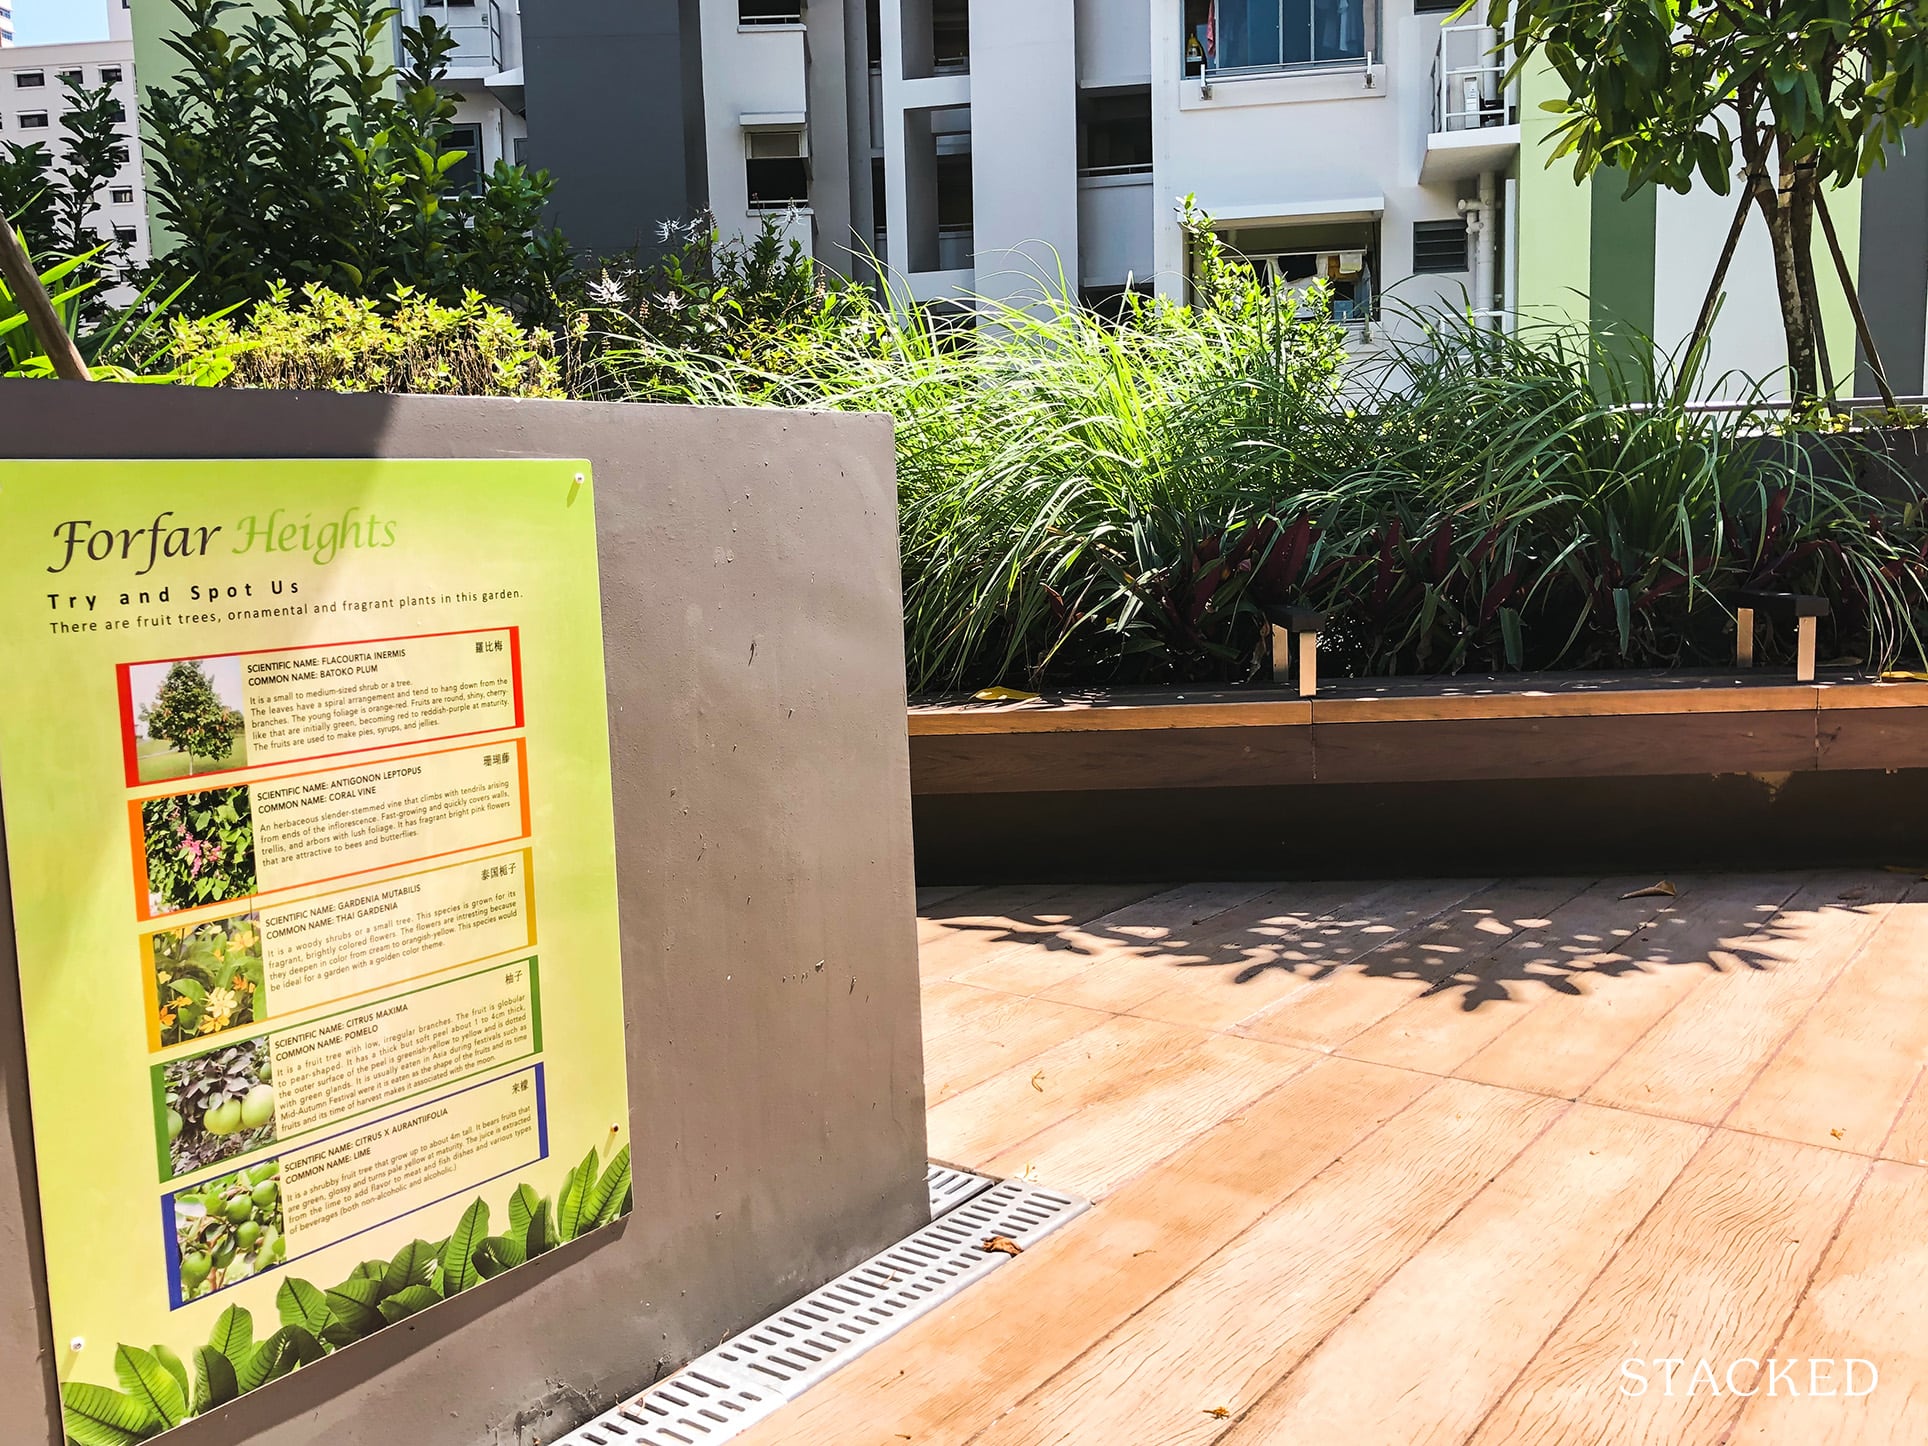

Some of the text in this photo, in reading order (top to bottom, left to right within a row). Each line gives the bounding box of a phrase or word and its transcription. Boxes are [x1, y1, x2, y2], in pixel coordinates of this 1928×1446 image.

[46, 506, 397, 576] Forfar Heights
[47, 580, 299, 611] Try and Spot Us
[49, 588, 522, 633] There are fruit trees, ornamental and fragrant plants in this garden.
[247, 648, 406, 673] SCIENTIFIC NAME: FLACOURTIA INERMIS
[247, 664, 378, 686] COMMON NAME: BATOKO PLUM
[249, 696, 256, 704] It
[257, 695, 264, 704] is
[272, 691, 293, 702] small
[305, 683, 357, 698] medium-sized
[358, 681, 379, 692] shrub
[291, 713, 306, 722] The
[307, 711, 331, 723] young
[332, 707, 358, 717] foliage
[360, 705, 366, 713] is
[410, 698, 430, 706] Fruits
[256, 765, 421, 801] SCIENTIFIC NAME: ANTIGONON LEPTOPUS
[257, 785, 376, 814] COMMON NAME: CORAL VINE
[259, 780, 509, 832] An herbaceous slender-stemmed vine that climbs with tendrils arising
[261, 857, 278, 866] that
[280, 855, 293, 863] are
[295, 847, 332, 860] attractive
[333, 844, 343, 852] to
[344, 840, 362, 850] bees
[364, 835, 378, 846] and
[265, 883, 421, 927] SCIENTIFIC NAME: GARDENIA MUTABILIS
[265, 901, 398, 939] COMMON NAME: THAI GARDENIA
[269, 970, 286, 980] they
[288, 962, 317, 975] deepen
[319, 959, 327, 967] in
[328, 954, 347, 965] color
[349, 950, 366, 959] from
[368, 943, 390, 954] cream
[457, 921, 471, 931] This
[472, 915, 496, 928] species
[497, 909, 517, 920] would
[305, 945, 336, 960] brightly
[338, 935, 367, 951] colored
[400, 926, 413, 935] The
[415, 919, 441, 931] flowers
[443, 916, 454, 924] are
[489, 901, 516, 912] because
[274, 1003, 408, 1049] SCIENTIFIC NAME: CITRUS MAXIMA
[275, 1024, 378, 1061] COMMON NAME: POMELO
[281, 1120, 301, 1132] fruits
[302, 1112, 317, 1125] and
[318, 1111, 327, 1119] its
[328, 1105, 345, 1115] time
[346, 1099, 354, 1109] of
[356, 1092, 382, 1106] harvest
[383, 1085, 405, 1097] makes
[406, 1082, 412, 1090] it
[412, 1068, 448, 1087] associated
[448, 1063, 463, 1075] with
[464, 1061, 475, 1070] the
[284, 1107, 448, 1172] SCIENTIFIC NAME: CITRUS X AURANTIIFOLIA
[285, 1146, 370, 1184] COMMON NAME: LIME
[287, 1203, 300, 1213] are
[327, 1183, 351, 1199] glossy
[352, 1175, 366, 1188] and
[367, 1170, 386, 1182] turns
[387, 1163, 402, 1176] pale
[403, 1155, 425, 1170] yellow
[427, 1151, 434, 1160] at
[465, 1135, 478, 1144] The
[479, 1129, 494, 1142] juice
[495, 1125, 501, 1133] is
[501, 1113, 531, 1131] extracted
[288, 1224, 297, 1234] of
[298, 1211, 338, 1231] beverages
[339, 1201, 359, 1216] (both
[360, 1183, 407, 1206] non-alcoholic
[408, 1175, 422, 1188] and
